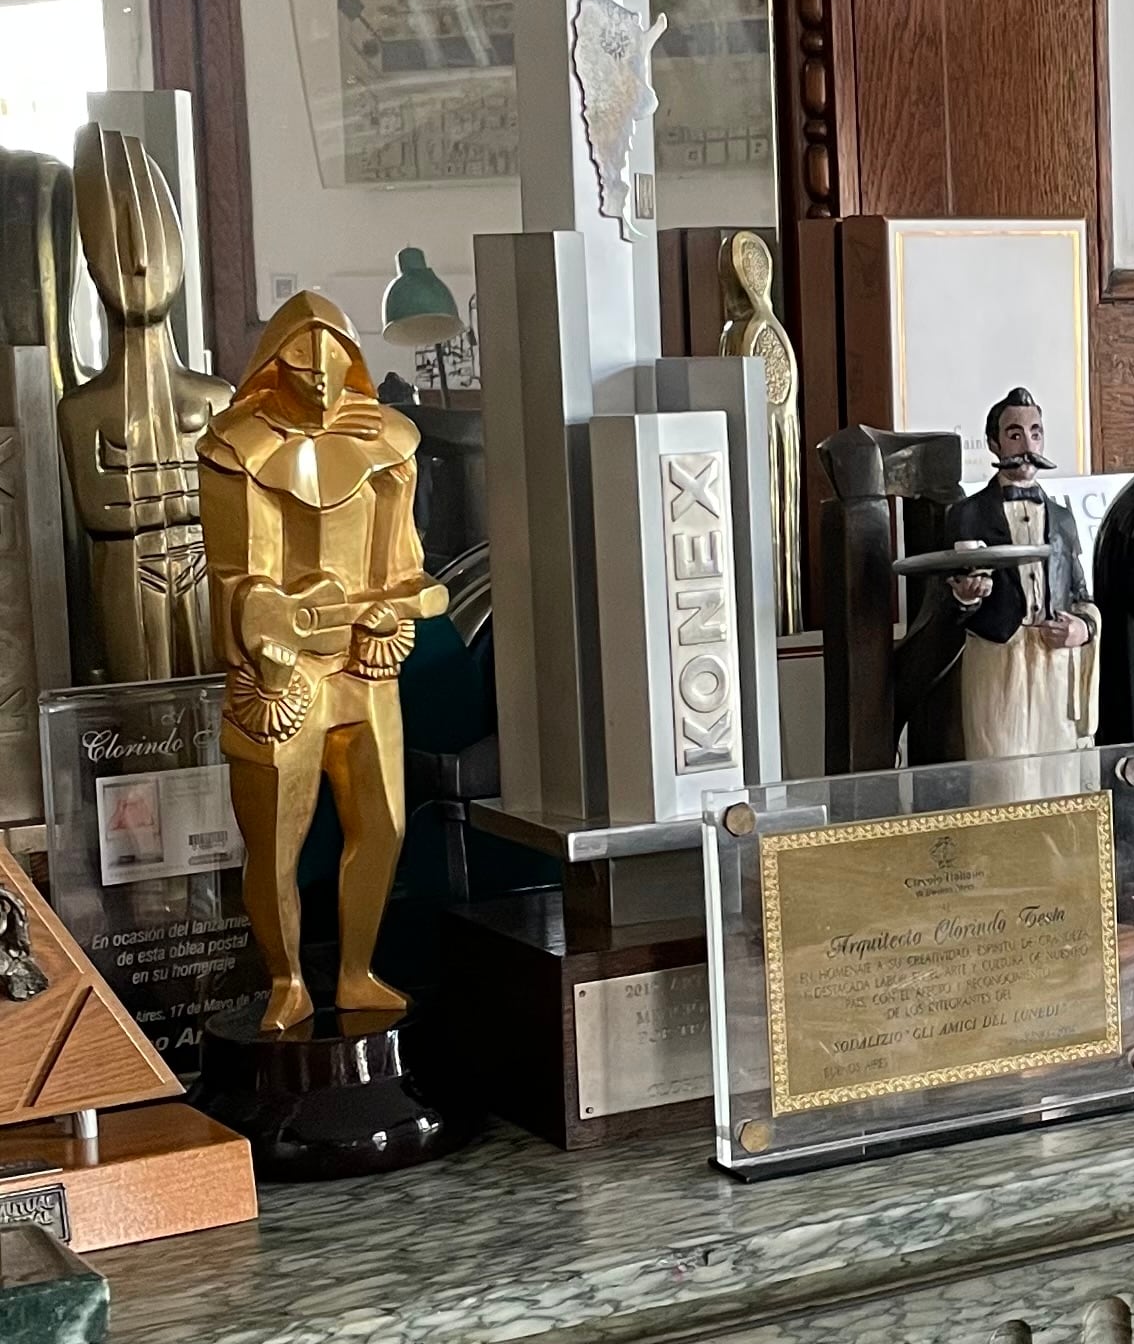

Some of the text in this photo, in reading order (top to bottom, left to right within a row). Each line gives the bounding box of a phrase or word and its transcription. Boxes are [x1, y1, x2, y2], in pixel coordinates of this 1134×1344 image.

[668, 458, 733, 768] KONEX
[82, 726, 184, 762] Clorindo
[92, 934, 109, 950] En
[168, 921, 190, 938] del
[191, 915, 251, 934] lanzamie
[117, 932, 249, 967] de esta oblea postal
[826, 928, 922, 961] Arquitecto
[934, 908, 1007, 945] Clorindo
[132, 956, 236, 984] en su homenaje
[171, 1006, 183, 1018] 17
[186, 1002, 200, 1015] de
[832, 1031, 903, 1054] SODALIZIO
[938, 1017, 977, 1035] AMICI
[982, 1012, 1007, 1028] DEL
